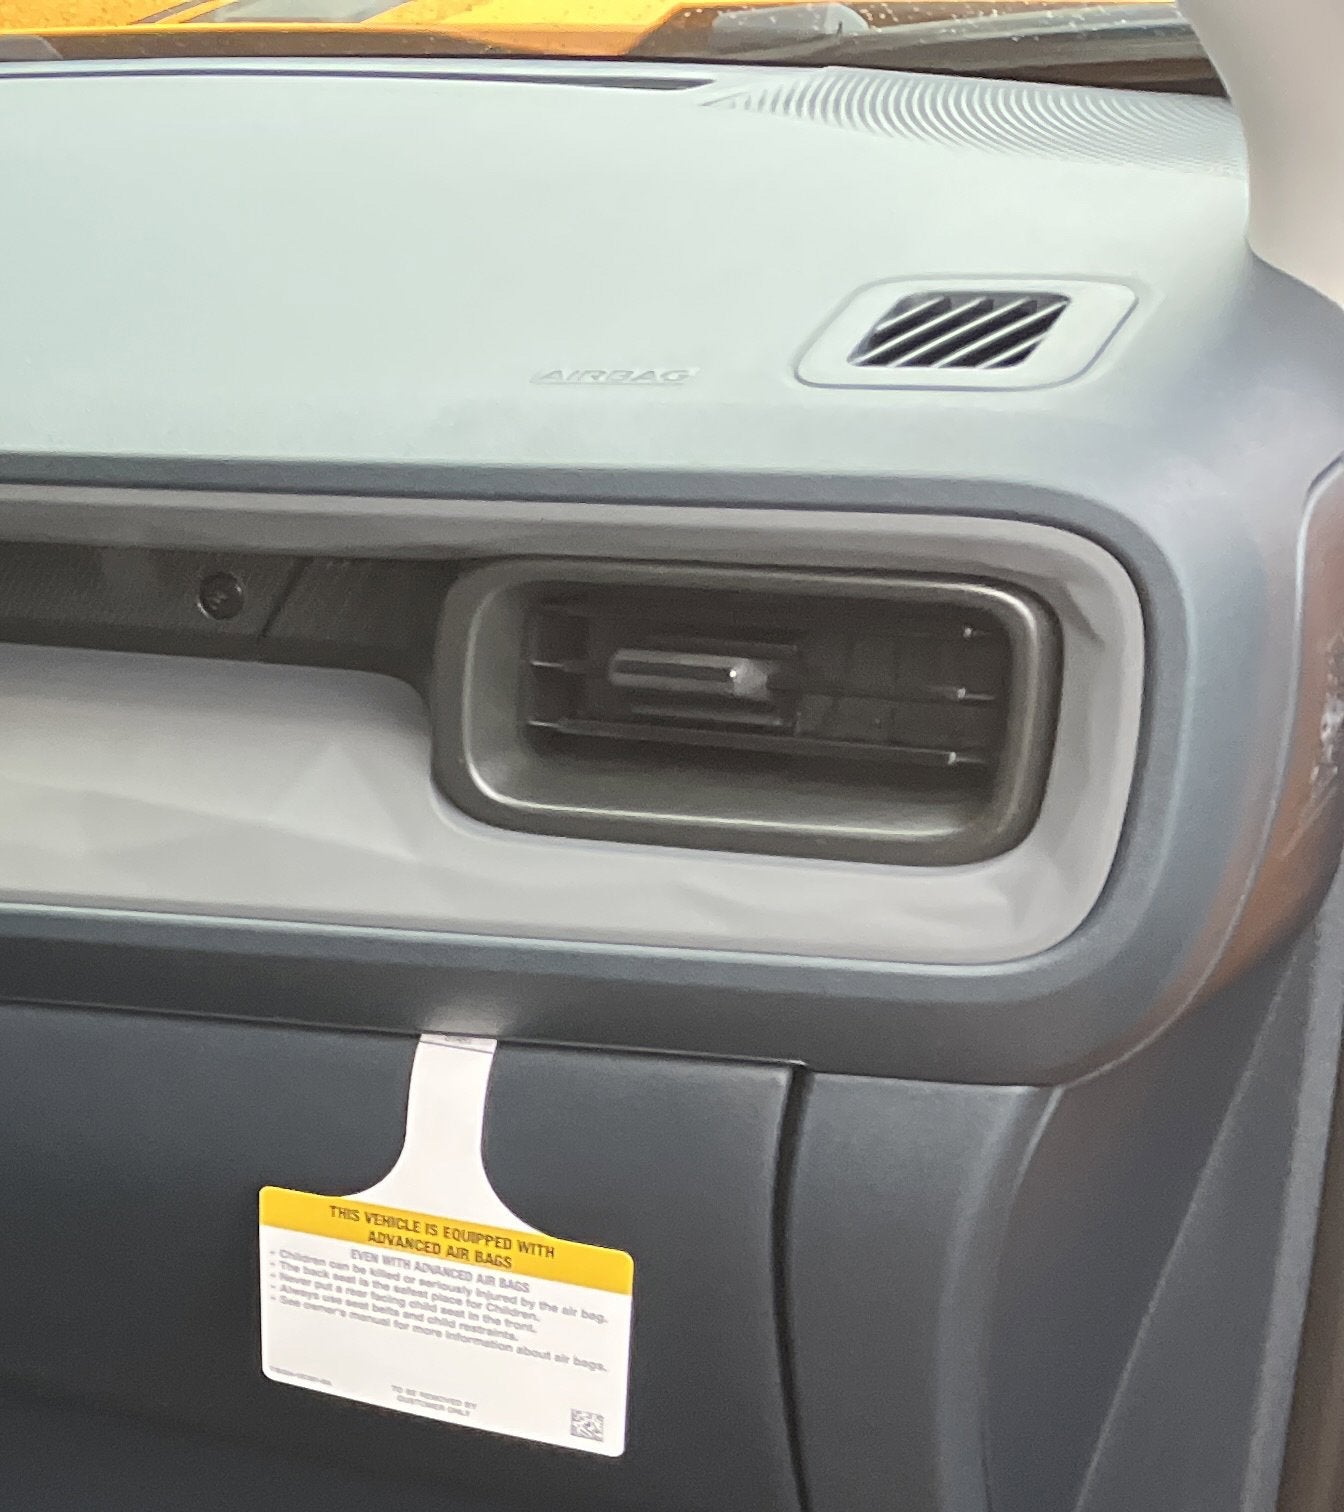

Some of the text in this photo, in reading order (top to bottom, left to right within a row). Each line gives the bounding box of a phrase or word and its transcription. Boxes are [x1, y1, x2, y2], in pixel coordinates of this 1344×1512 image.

[534, 368, 693, 383] AIRBAG
[329, 1205, 555, 1259] THIS VEHICLE IS EQUIPPED WITH
[367, 1230, 512, 1269] ADVANCED AIR BAGS
[279, 1260, 300, 1273] The
[372, 1279, 390, 1291] the
[279, 1249, 326, 1266] Children
[329, 1261, 350, 1271] can
[352, 1264, 367, 1275] be
[403, 1275, 416, 1284] or
[520, 1297, 536, 1310] by
[539, 1301, 558, 1313] the
[562, 1306, 577, 1317] air
[350, 1249, 530, 1294] EVEN WITH ADVANCED AIR BAGS
[482, 1314, 501, 1326] the
